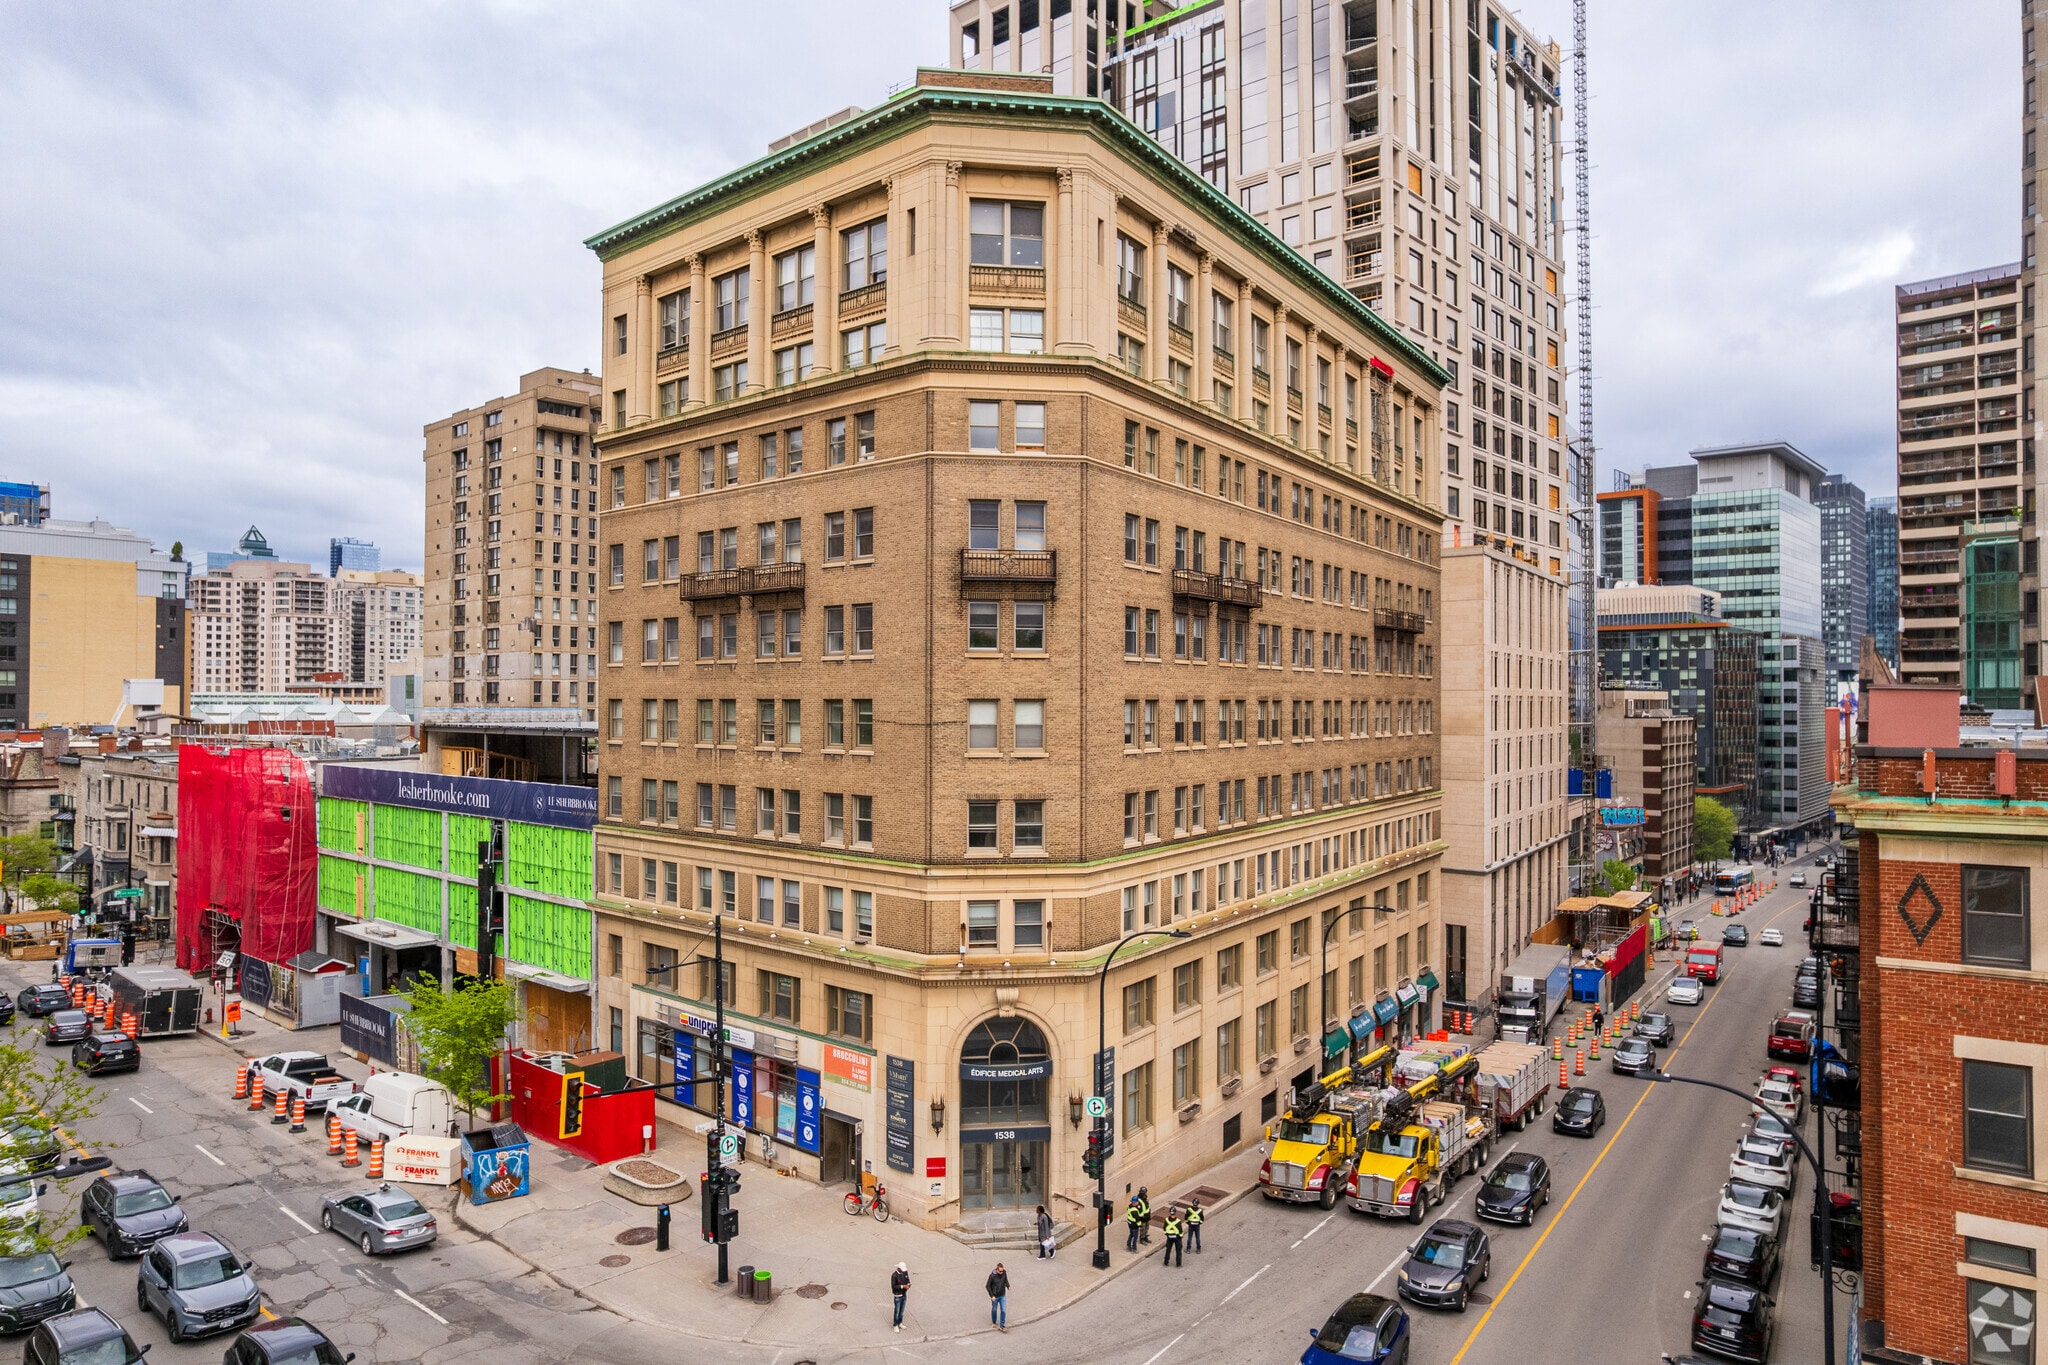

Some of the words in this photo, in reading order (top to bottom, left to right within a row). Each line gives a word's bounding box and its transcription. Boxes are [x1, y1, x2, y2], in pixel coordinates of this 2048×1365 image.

[398, 778, 490, 808] lesherbrooke.com
[556, 797, 597, 811] SHERBROOKE
[220, 957, 231, 967] 50
[350, 1013, 385, 1037] SHERBROOKE
[833, 1048, 868, 1066] BROCCOLINI
[892, 1059, 903, 1067] 1538
[971, 1068, 996, 1077] ÉDIFICE
[998, 1069, 1027, 1077] MEDICAL
[1028, 1067, 1043, 1075] ARTS
[994, 1131, 1015, 1140] 1538
[406, 1149, 440, 1158] FRANSYL
[404, 1166, 439, 1175] FRANSYL
